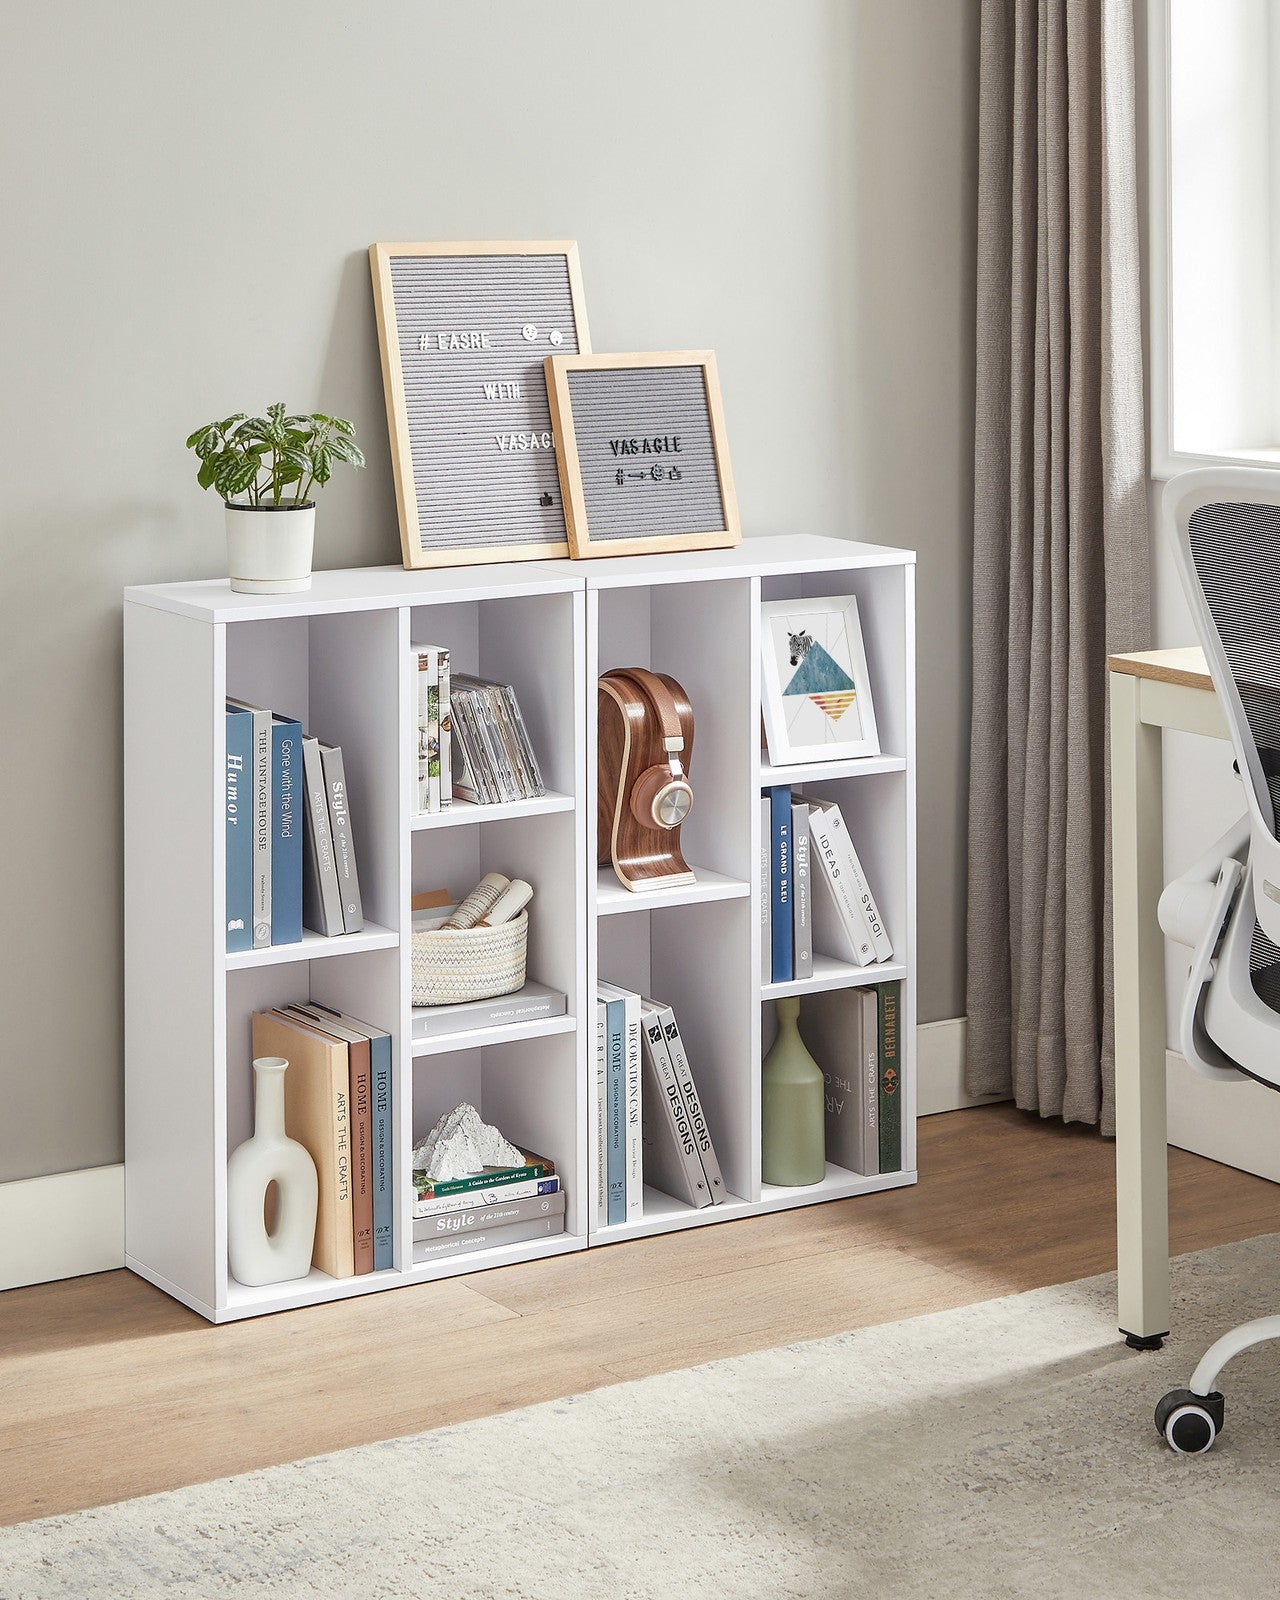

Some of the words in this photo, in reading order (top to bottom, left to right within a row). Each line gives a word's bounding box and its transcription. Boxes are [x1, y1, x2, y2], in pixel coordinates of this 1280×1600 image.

[438, 332, 490, 350] EASRE
[483, 382, 520, 400] WITH
[610, 436, 682, 456] VASAGLE
[282, 740, 293, 766] Gone
[228, 754, 242, 825] Humor
[282, 768, 292, 790] with
[282, 792, 292, 810] the
[314, 792, 324, 814] ARTS
[332, 782, 346, 826] Style
[258, 810, 266, 850] HOUSE
[282, 812, 292, 838] Wind
[318, 817, 326, 834] THE
[780, 826, 786, 836] LE
[320, 839, 331, 872] CRAFTS
[780, 842, 788, 874] GRAND
[797, 836, 808, 877] Style
[820, 834, 840, 878] IDEAS
[861, 894, 882, 938] IDEAS
[612, 1033, 621, 1072] HOME
[629, 1023, 638, 1097] DECORATION
[357, 1074, 367, 1115] HOME
[377, 1071, 387, 1112] HOME
[825, 1094, 844, 1115] AR
[336, 1092, 346, 1122] ARTS
[630, 1099, 638, 1128] CASE
[666, 1084, 694, 1156] DESIGNS
[682, 1081, 710, 1152] DESIGNS
[338, 1127, 347, 1151] THE
[339, 1156, 348, 1200] CRAFTS
[436, 1214, 475, 1231] Style
[425, 1241, 460, 1254] Metaphorical
[462, 1236, 486, 1246] Concepts
